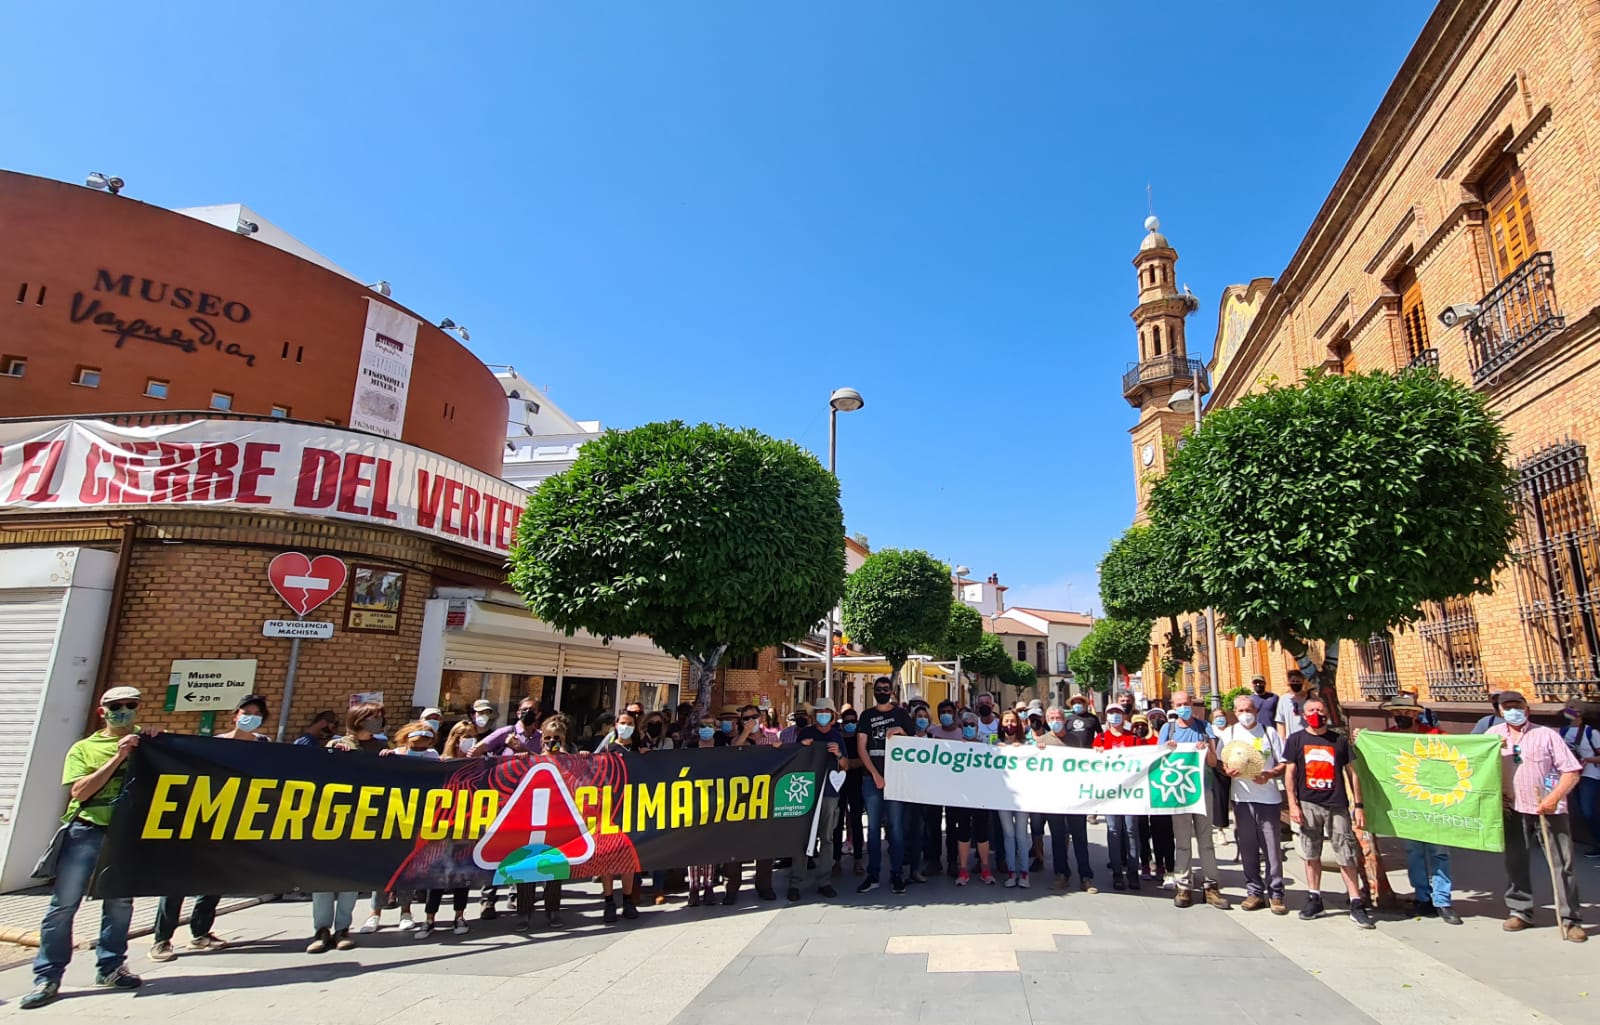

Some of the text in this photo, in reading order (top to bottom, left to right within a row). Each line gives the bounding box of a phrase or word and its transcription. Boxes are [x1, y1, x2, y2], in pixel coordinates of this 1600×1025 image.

[93, 268, 251, 323] MUSEO
[6, 439, 65, 502] EL
[79, 441, 281, 504] CIERRE
[294, 447, 397, 520] DEL
[187, 681, 225, 689] Vázquez
[890, 745, 1142, 773] ecologistas en acción
[1079, 784, 1144, 800] Huelva
[1309, 778, 1333, 789] CGT
[141, 766, 771, 840] EMERGENCIA CLIMÁTICA
[774, 804, 806, 812] ecologistas
[1390, 807, 1484, 830] LOS VERDES
